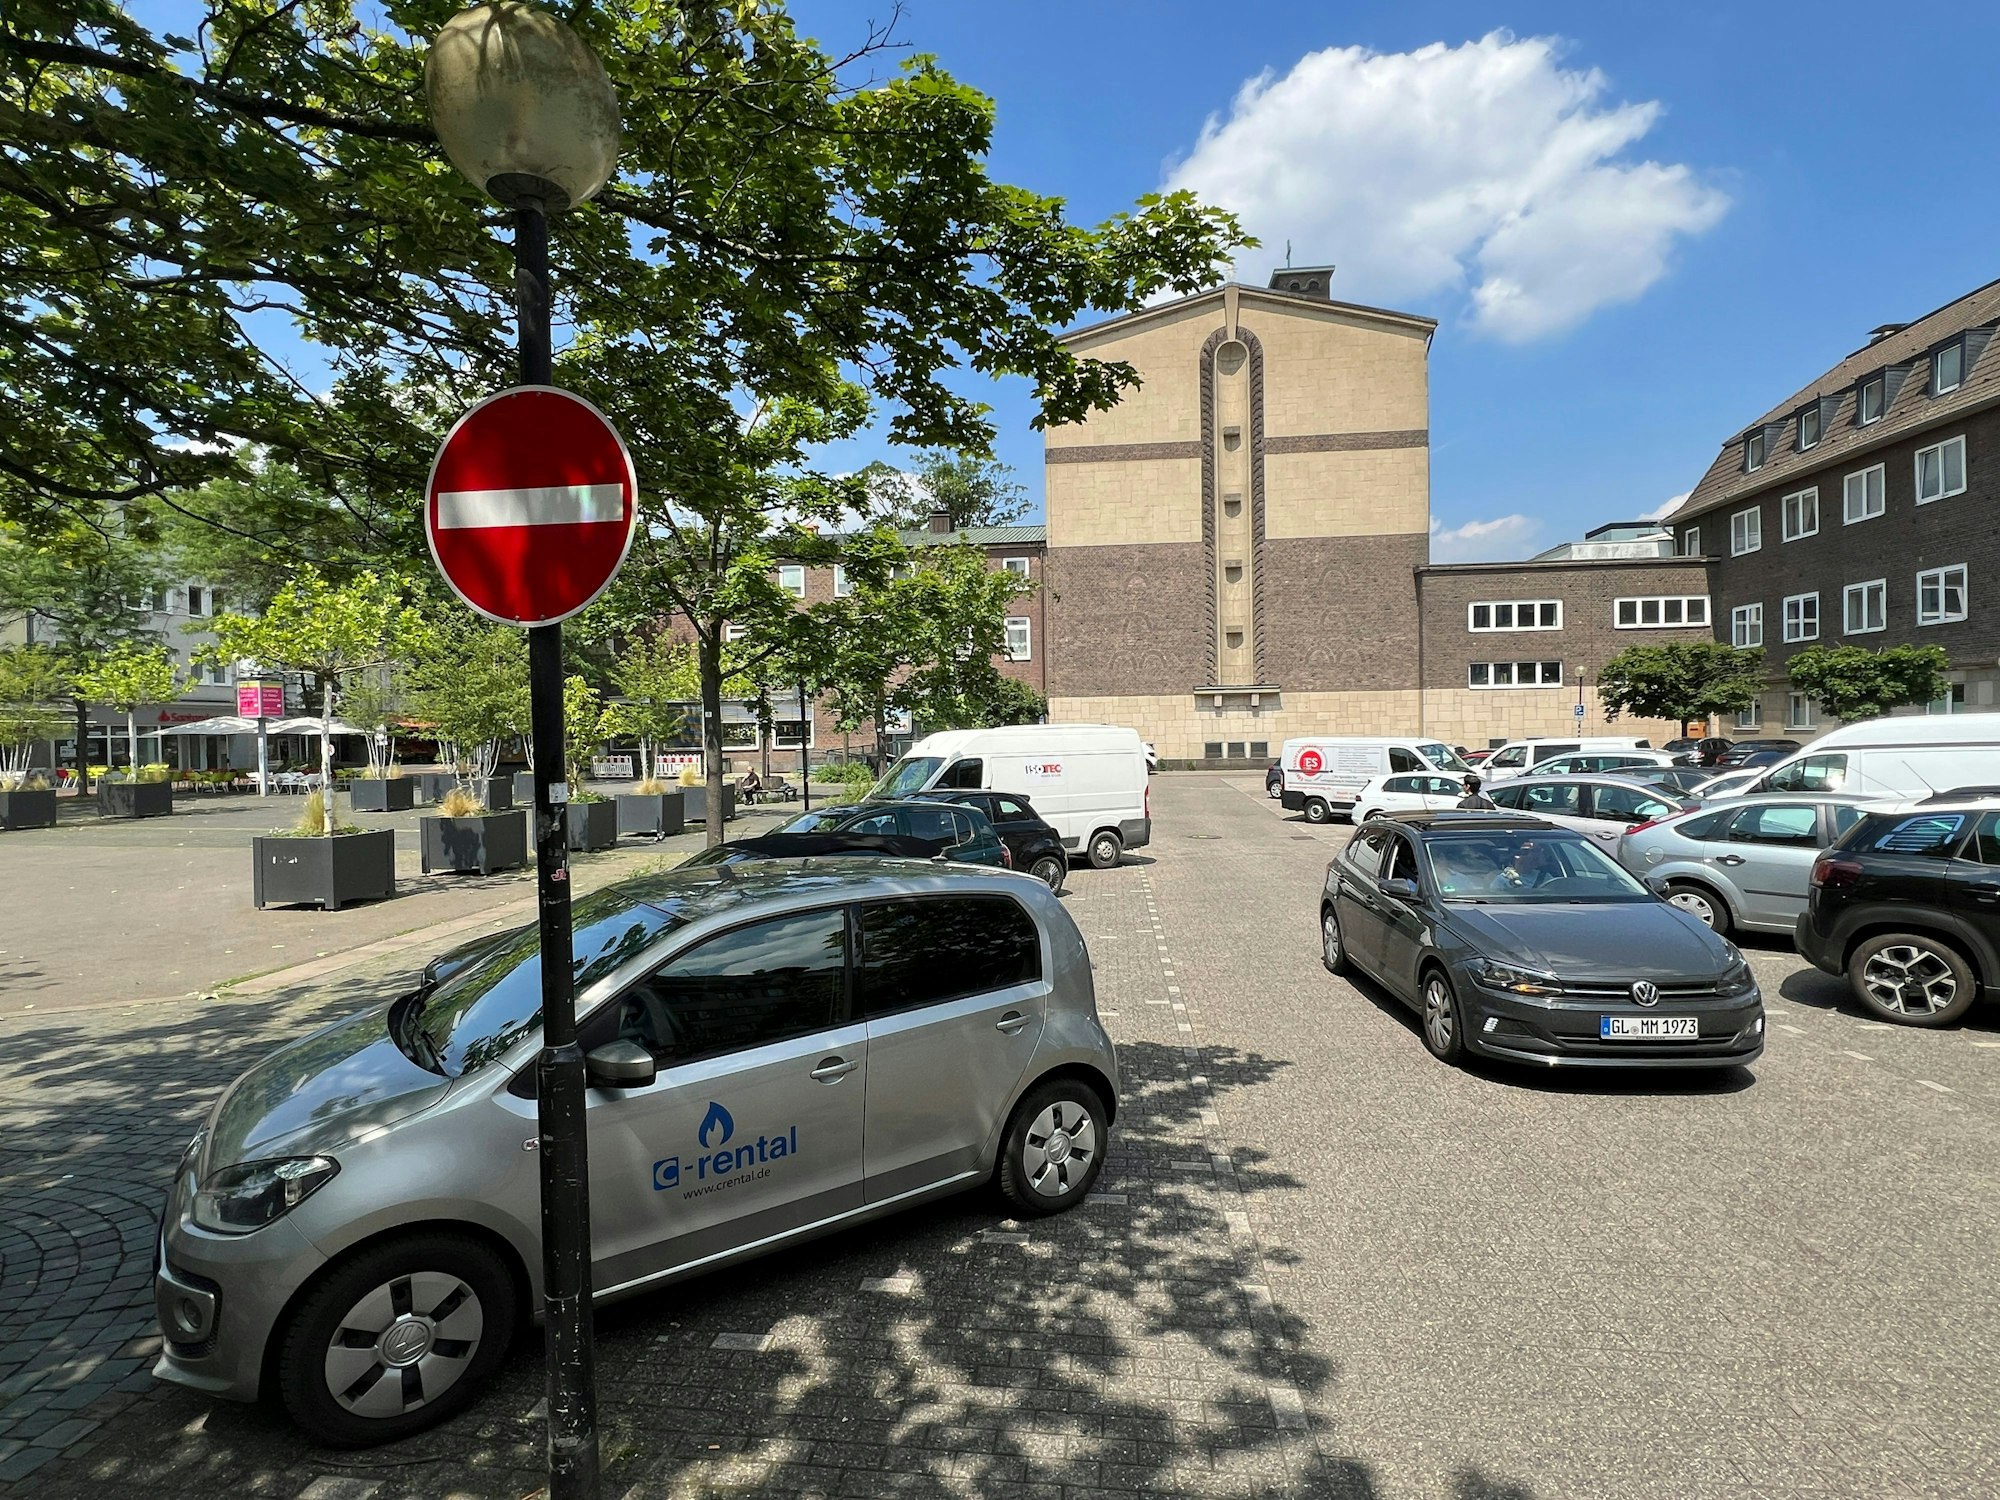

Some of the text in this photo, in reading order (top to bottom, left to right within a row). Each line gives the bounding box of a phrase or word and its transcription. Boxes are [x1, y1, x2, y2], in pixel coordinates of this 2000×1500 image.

[1025, 764, 1063, 775] ISOTEC
[1611, 1019, 1696, 1034] GL MM 1973
[682, 1167, 772, 1200] www.crental.de
